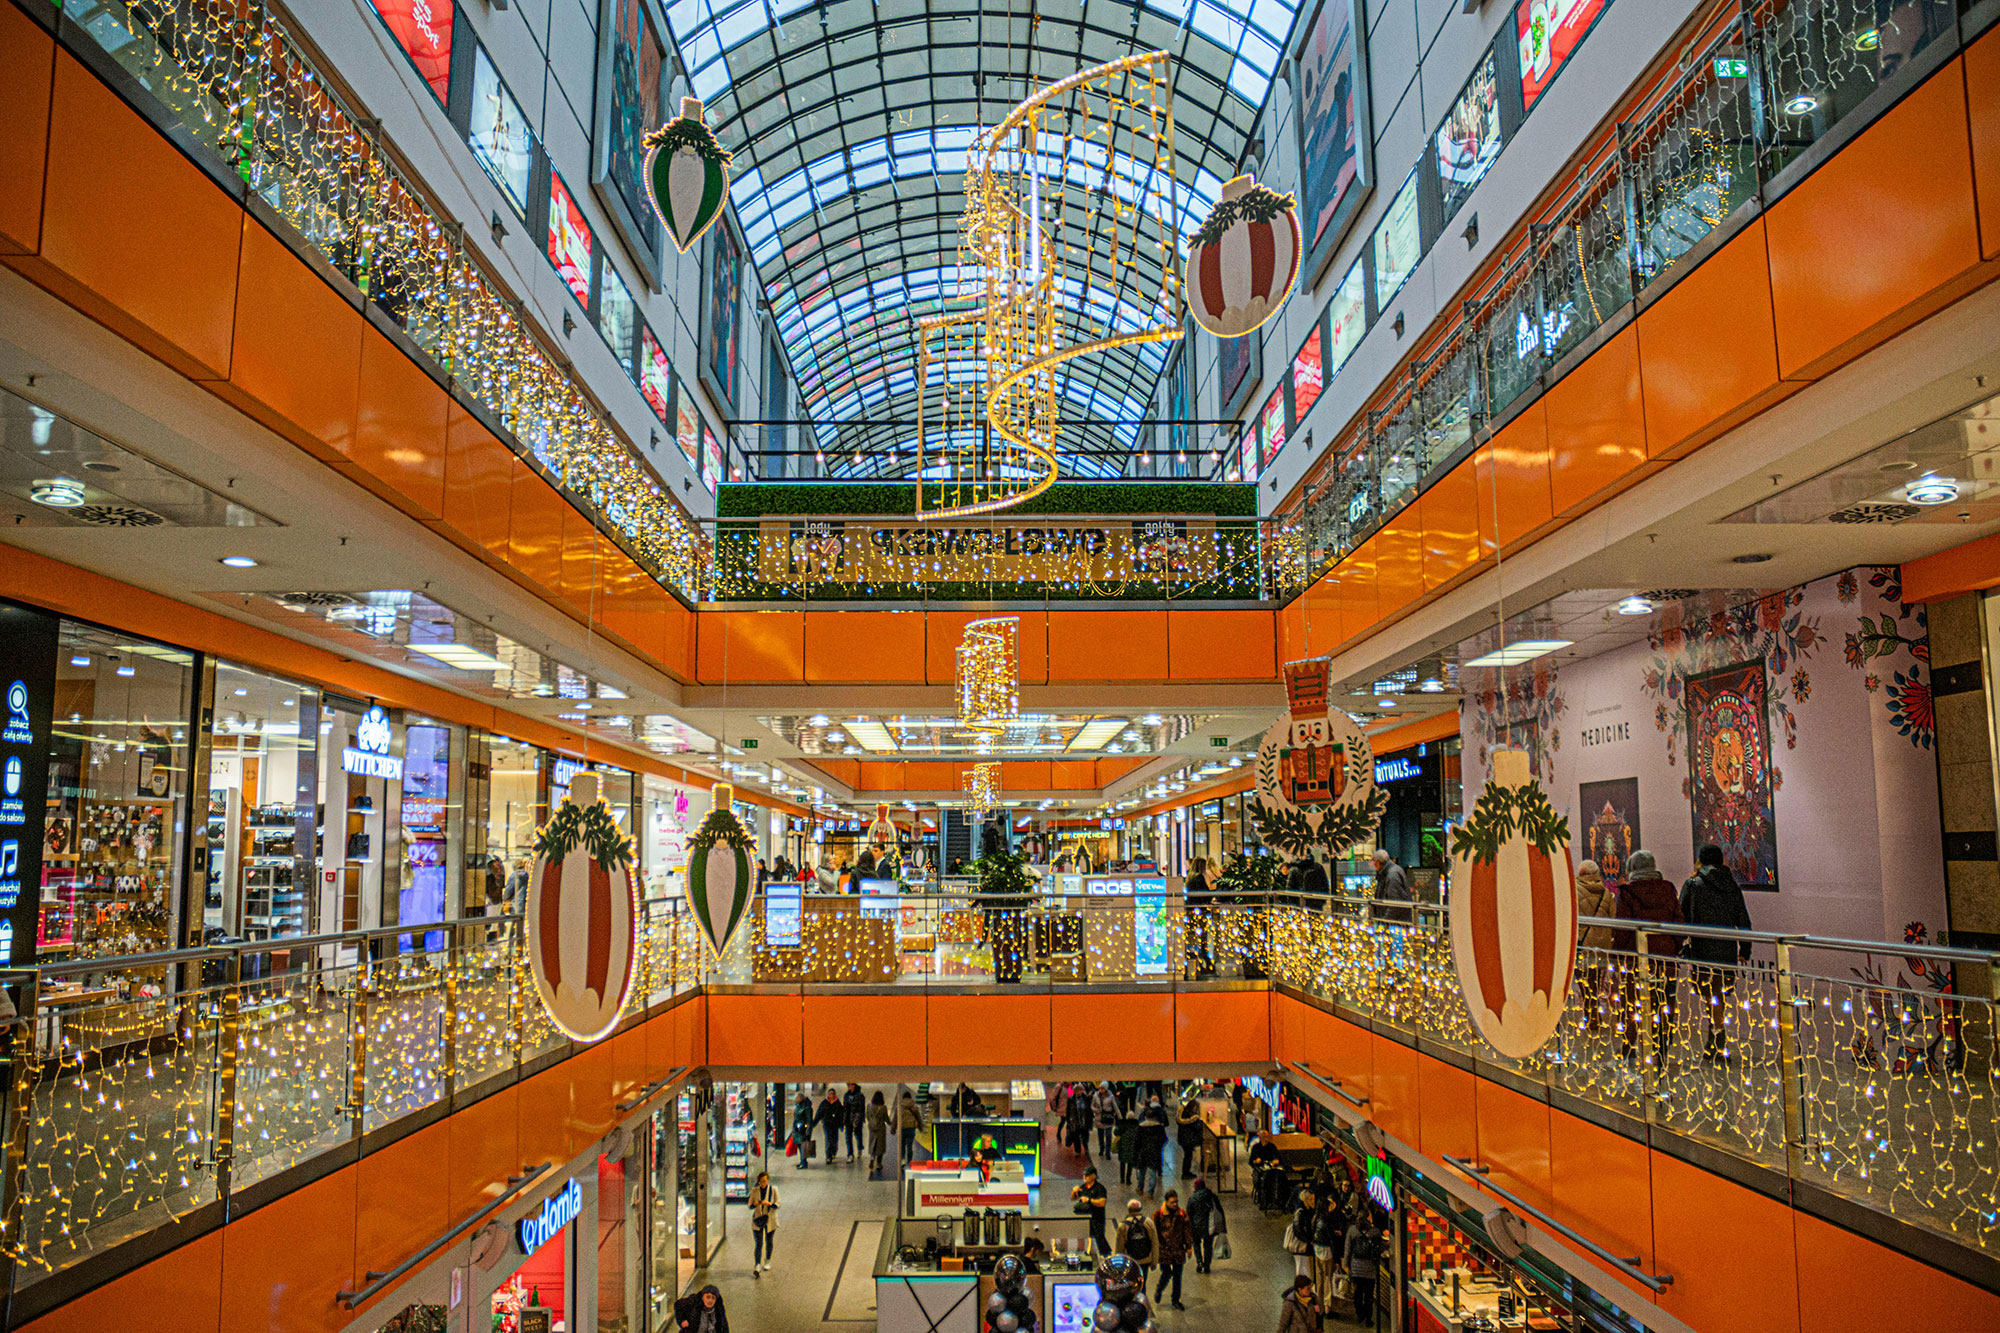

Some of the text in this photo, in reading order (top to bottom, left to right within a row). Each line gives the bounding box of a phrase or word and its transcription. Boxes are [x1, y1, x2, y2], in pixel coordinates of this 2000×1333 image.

[9, 719, 29, 729] zobacz
[1581, 722, 1630, 747] MEDICINE
[342, 751, 402, 780] WITTCHEN
[1376, 761, 1420, 782] RITUALS...
[402, 813, 433, 823] DAYS
[1088, 881, 1133, 895] IQOS
[929, 1195, 974, 1203] Millennium
[538, 1177, 582, 1247] Homla
